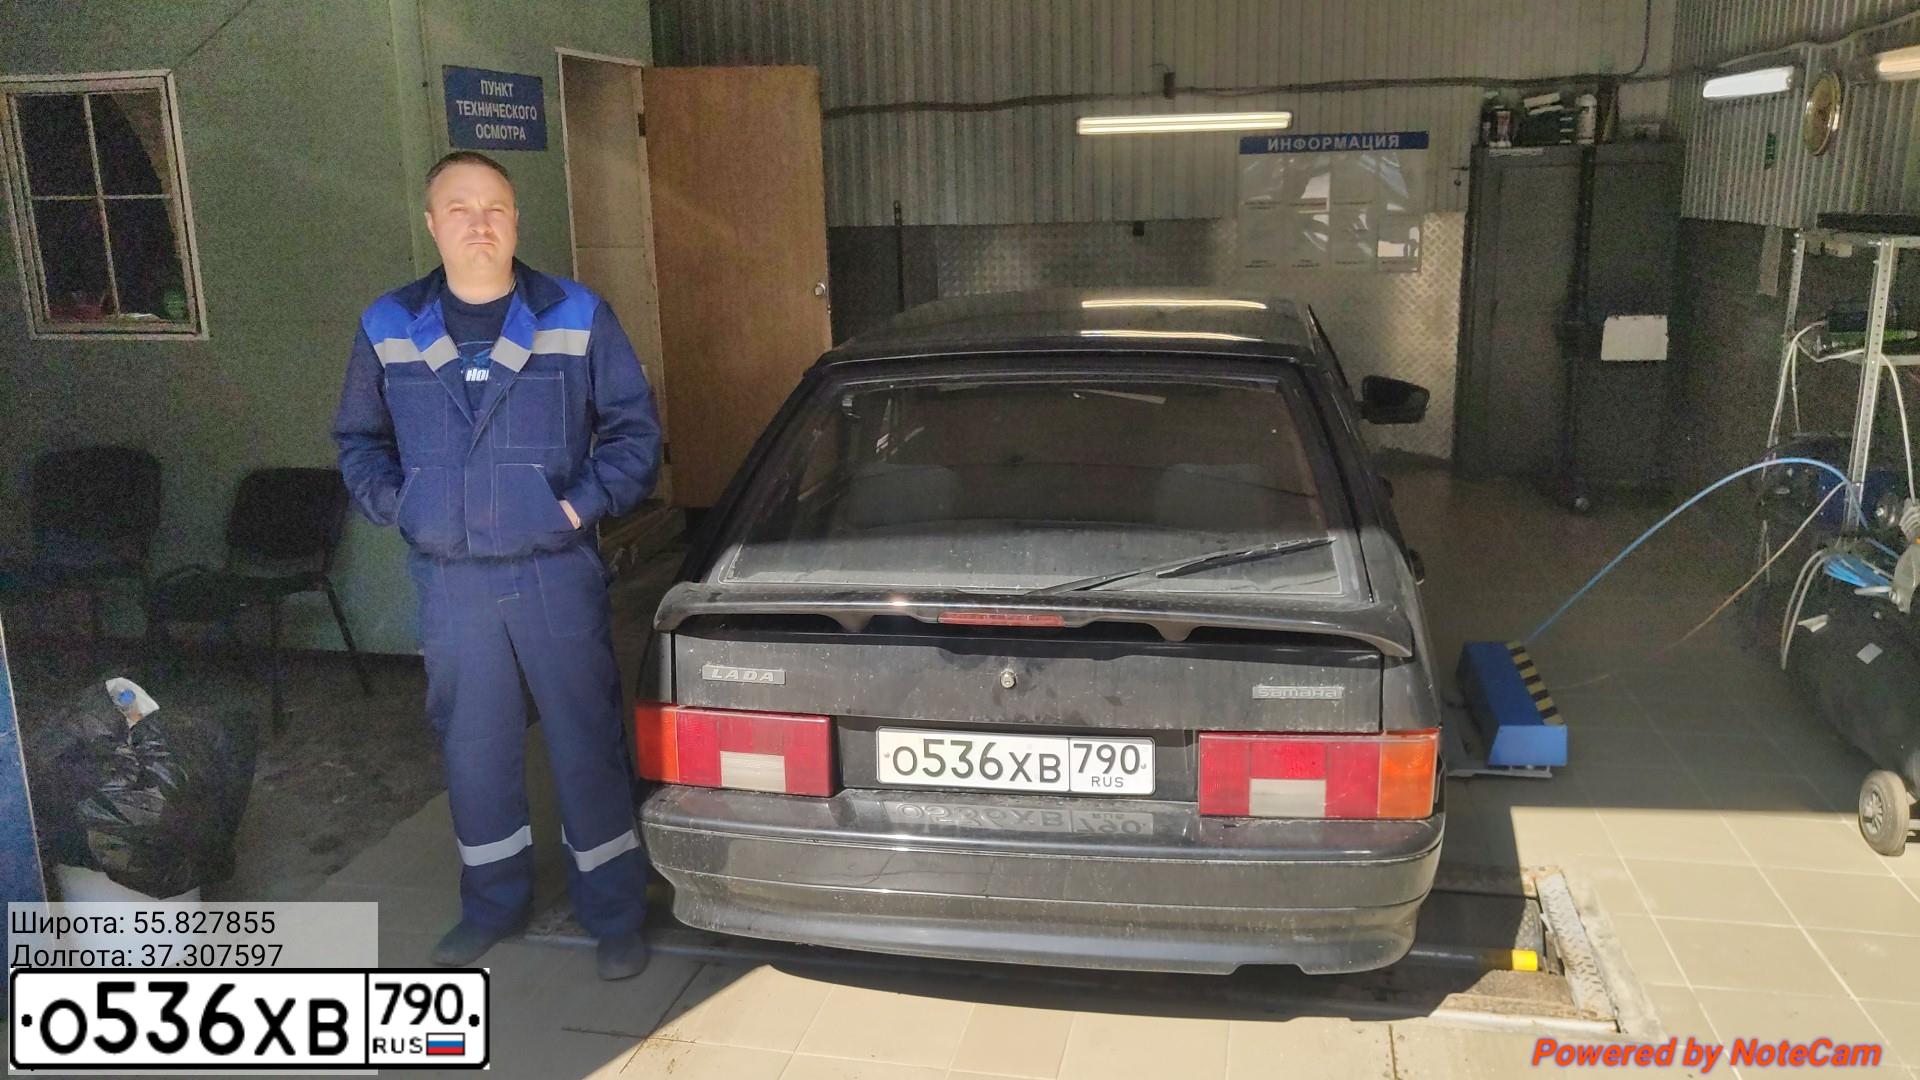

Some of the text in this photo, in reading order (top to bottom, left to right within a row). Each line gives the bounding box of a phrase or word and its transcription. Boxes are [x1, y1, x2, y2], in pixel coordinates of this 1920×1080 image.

[480, 80, 514, 97] ПУНКТ
[456, 100, 537, 120] ТЕХНИЧЕСКОГО
[475, 124, 526, 140] ОСМОТРА
[1267, 134, 1400, 151] ИНФОРМАЦИЯ
[711, 668, 774, 682] LADA
[1073, 743, 1141, 775] 790
[1091, 776, 1125, 788] RUS
